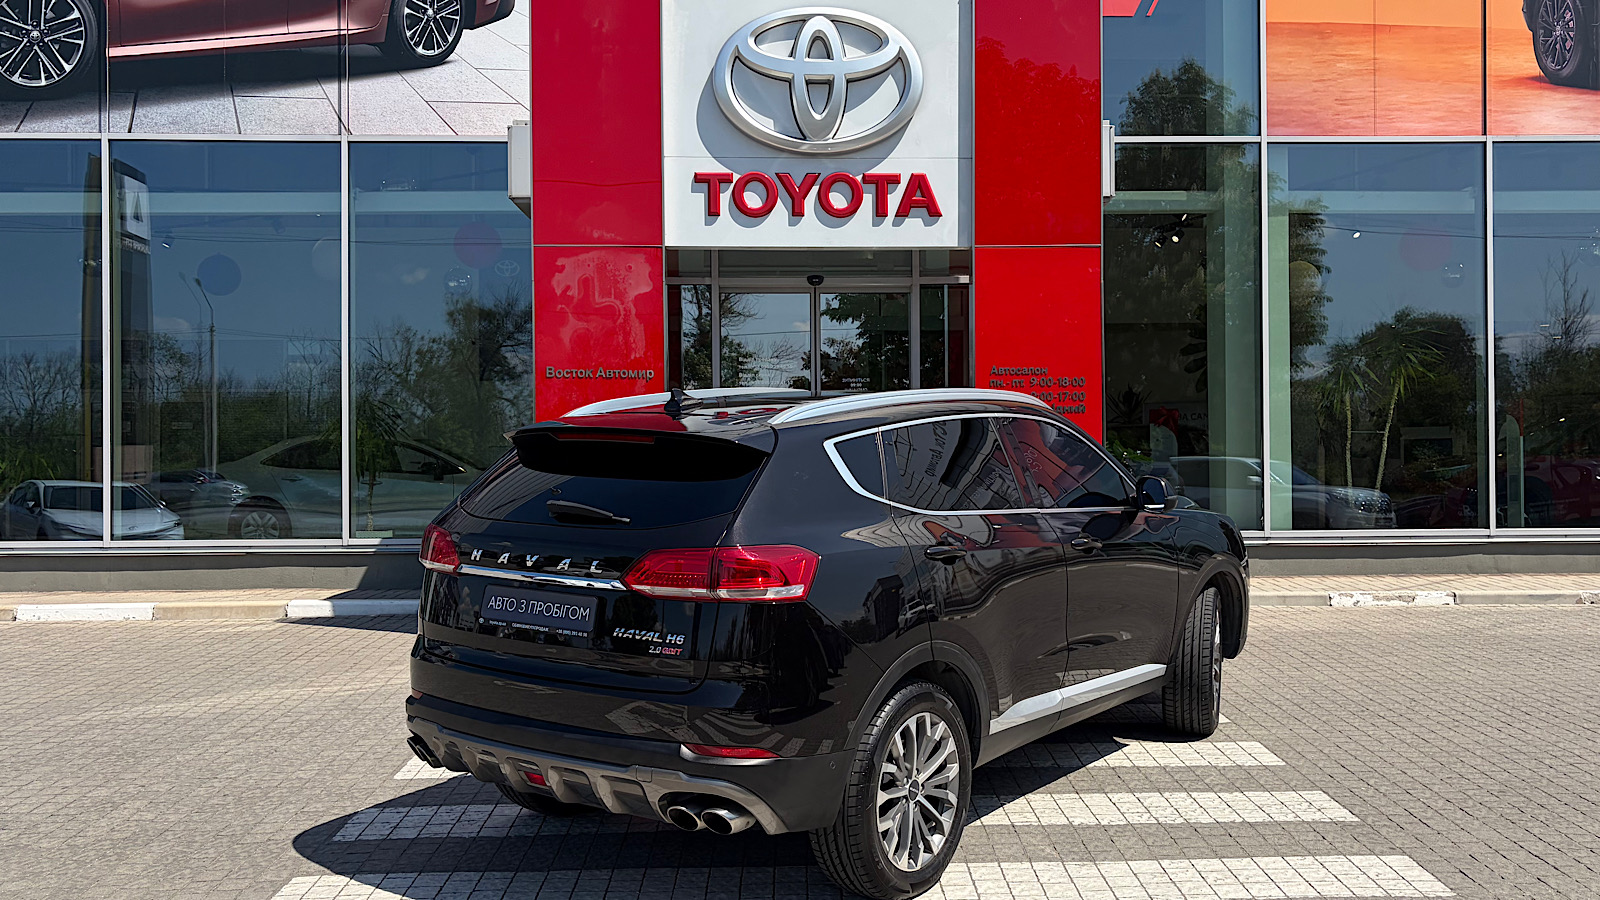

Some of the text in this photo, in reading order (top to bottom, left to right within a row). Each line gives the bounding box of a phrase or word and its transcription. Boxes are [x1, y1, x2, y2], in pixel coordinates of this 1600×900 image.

[694, 171, 943, 218] TOYOTA
[546, 366, 655, 382] Восток Автомир
[990, 365, 1049, 376] Автосалон
[1029, 377, 1087, 388] 9:00-18:00
[471, 549, 602, 573] HAVAL
[488, 596, 517, 611] АВТО
[528, 601, 590, 621] ПРОБІГОМ
[613, 628, 686, 644] HAVAL H6
[649, 645, 662, 653] 2.0
